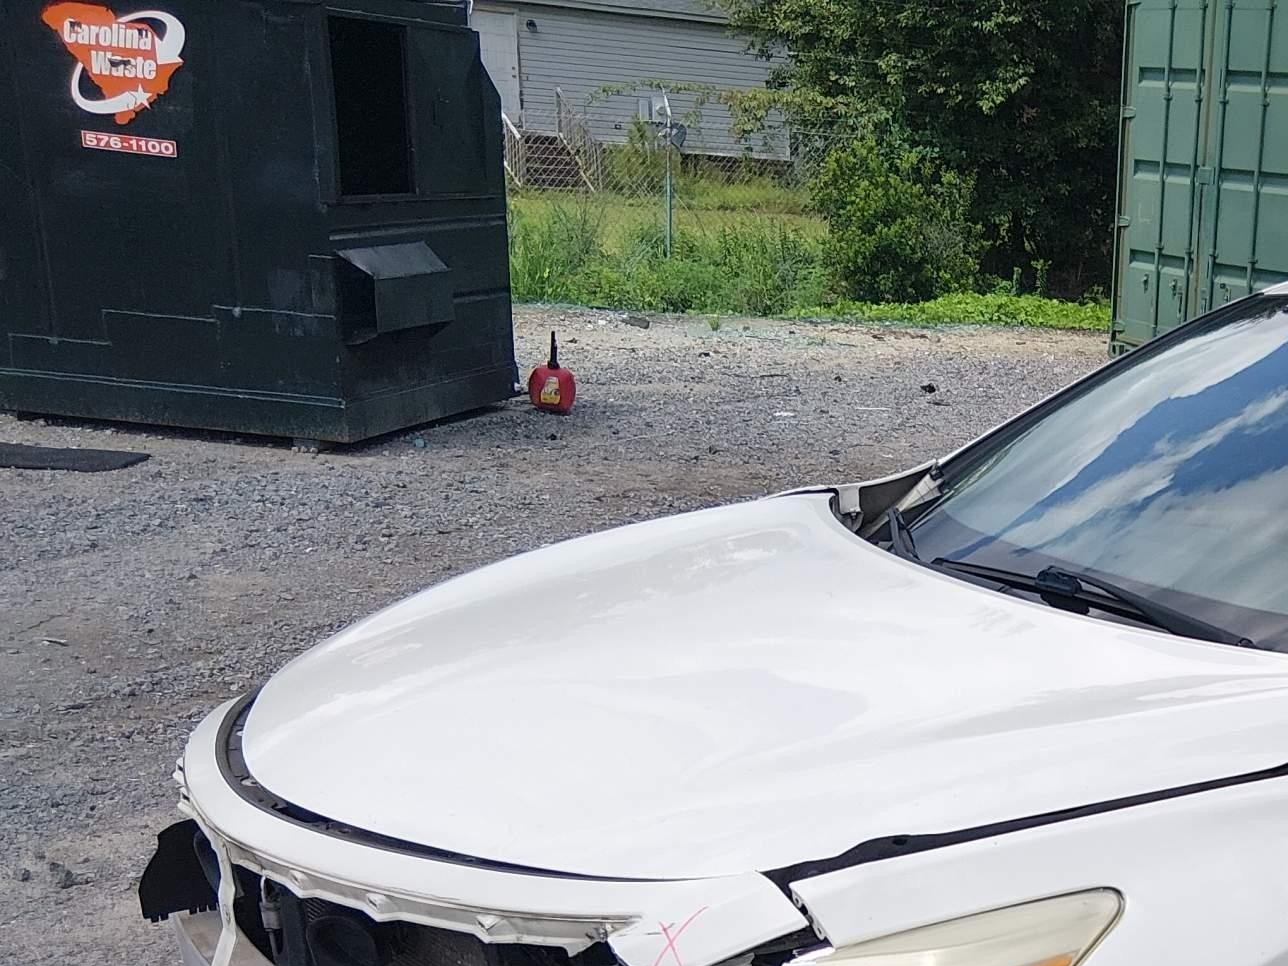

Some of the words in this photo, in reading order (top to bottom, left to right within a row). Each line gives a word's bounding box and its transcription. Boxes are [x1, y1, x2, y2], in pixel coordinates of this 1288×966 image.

[63, 18, 152, 50] Carolina
[90, 50, 157, 80] Waste
[86, 134, 174, 154] 576-1100
